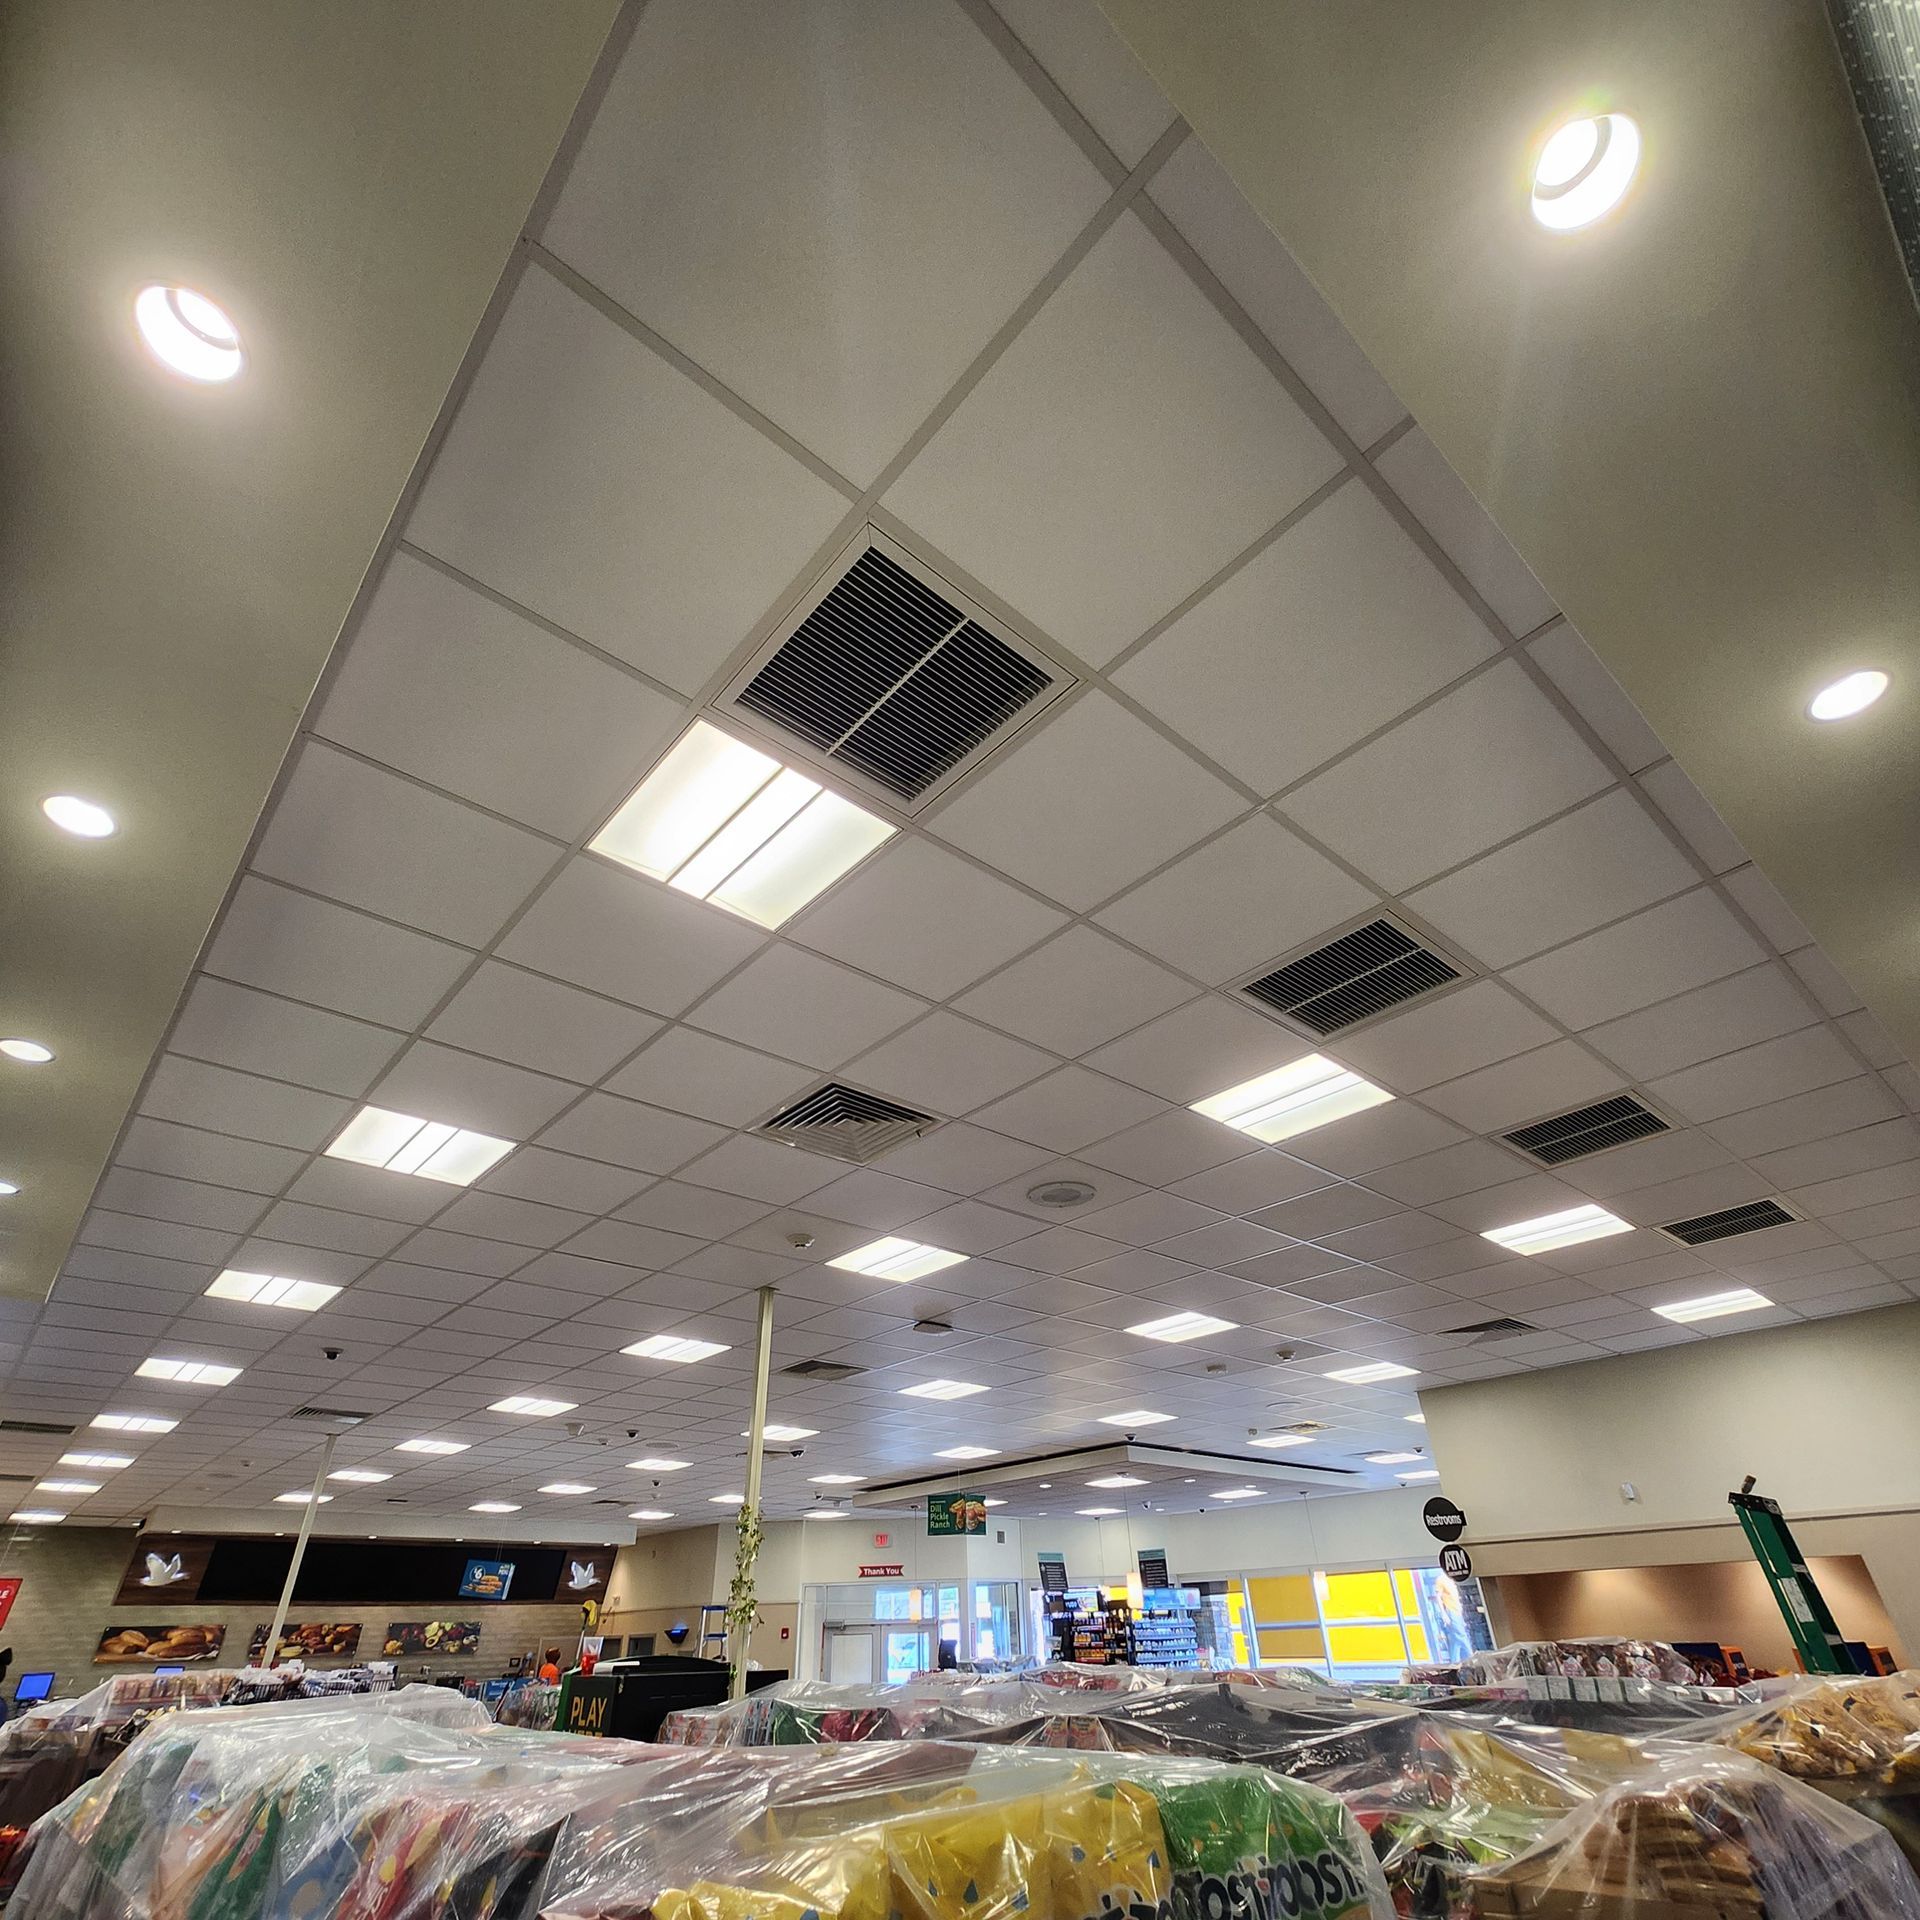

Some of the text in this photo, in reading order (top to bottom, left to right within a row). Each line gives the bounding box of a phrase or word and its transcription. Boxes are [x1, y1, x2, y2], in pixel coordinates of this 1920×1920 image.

[930, 1504, 942, 1513] Dill
[930, 1513, 949, 1521] Pickle
[1425, 1514, 1462, 1526] Restrooms
[930, 1521, 951, 1529] Ranch
[1444, 1550, 1468, 1571] ATM
[863, 1567, 900, 1576] Thank You
[570, 1696, 608, 1728] PLAY
